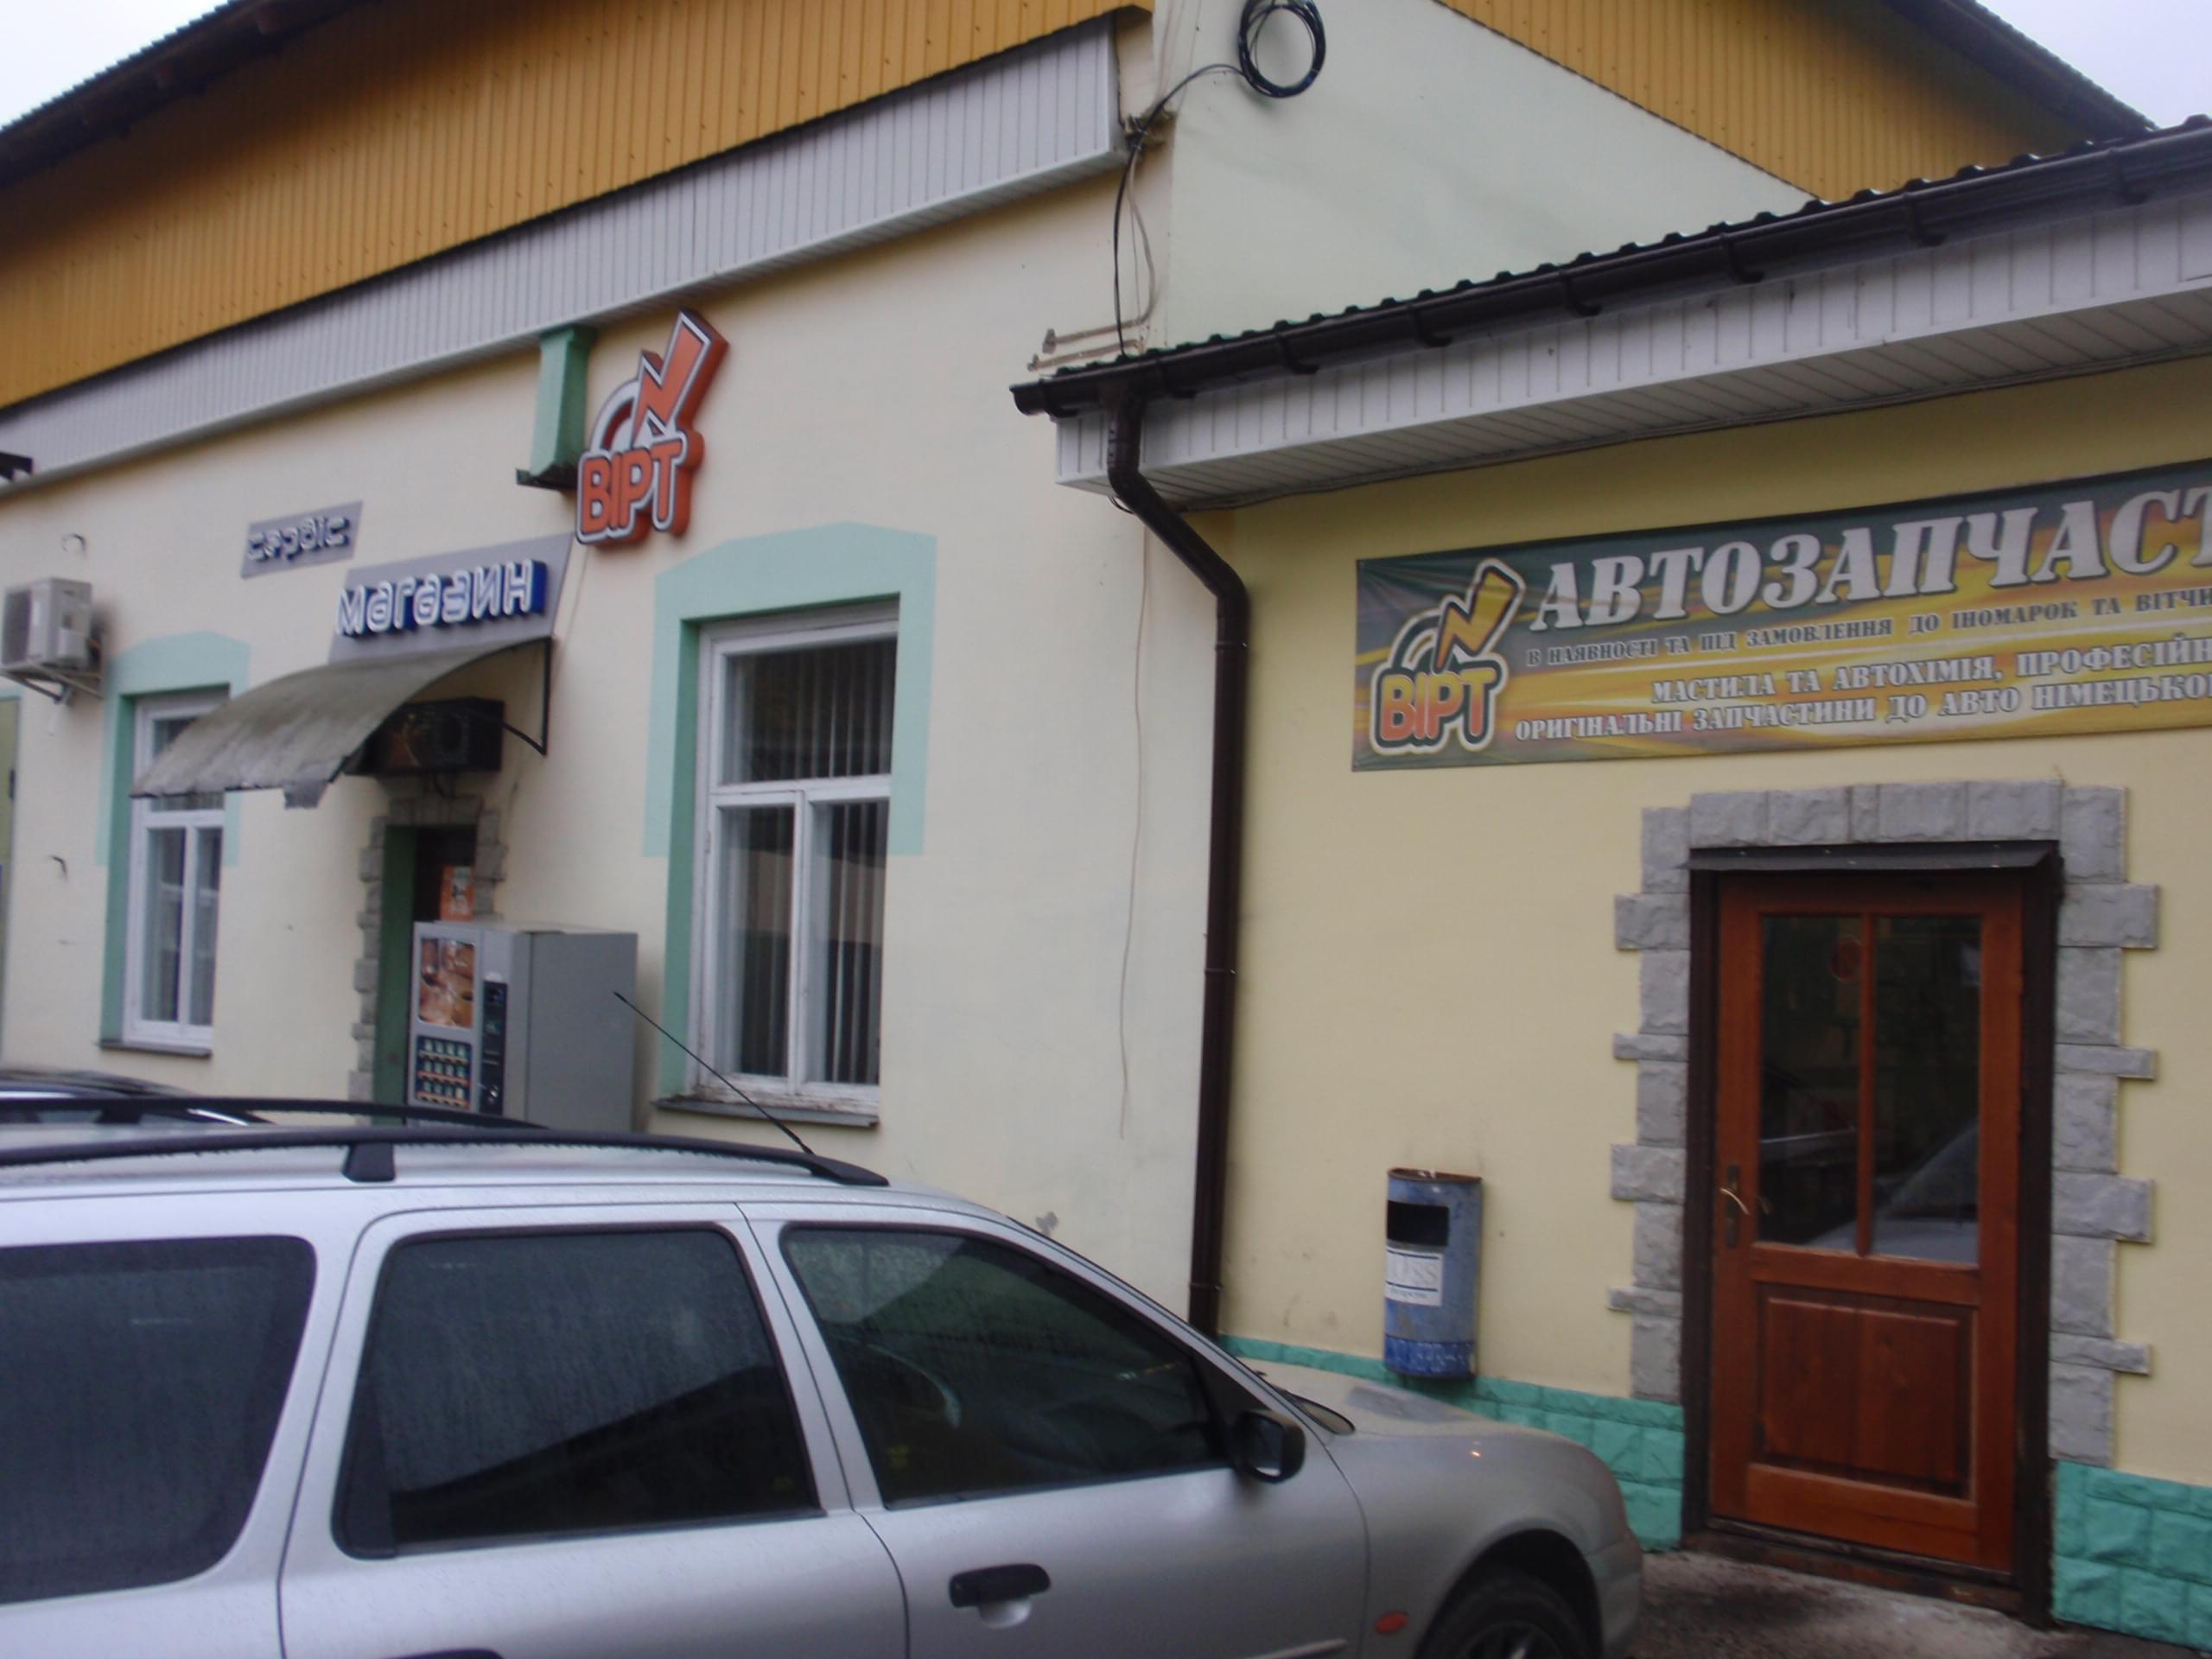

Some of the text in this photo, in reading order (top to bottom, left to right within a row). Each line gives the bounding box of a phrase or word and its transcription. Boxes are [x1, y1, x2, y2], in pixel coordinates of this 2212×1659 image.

[578, 437, 686, 539] ВІРТ
[335, 558, 546, 637] магазин
[1527, 649, 1541, 666] В
[1548, 639, 1657, 665] НАЯВНОСТІ
[1666, 636, 1690, 654] ТА
[1700, 632, 1737, 652] ПІД
[1746, 618, 1893, 647] ЗАМОВЛЕННЯ
[1909, 613, 1940, 634] ДО
[1952, 602, 2078, 629] ІНОМАРОК
[2091, 597, 2120, 616] ТА
[1379, 664, 1500, 745] ВІРТ
[1516, 672, 2212, 741] ОРИГІНАЛЬНІ ЗАПЧАСТИНИ ДО АВТО НІМЕЦЬКО
[1651, 673, 1776, 704] МАСТИЛА
[1786, 669, 1821, 694] ТА
[1832, 654, 2004, 691] АВТОХІМІЯ,
